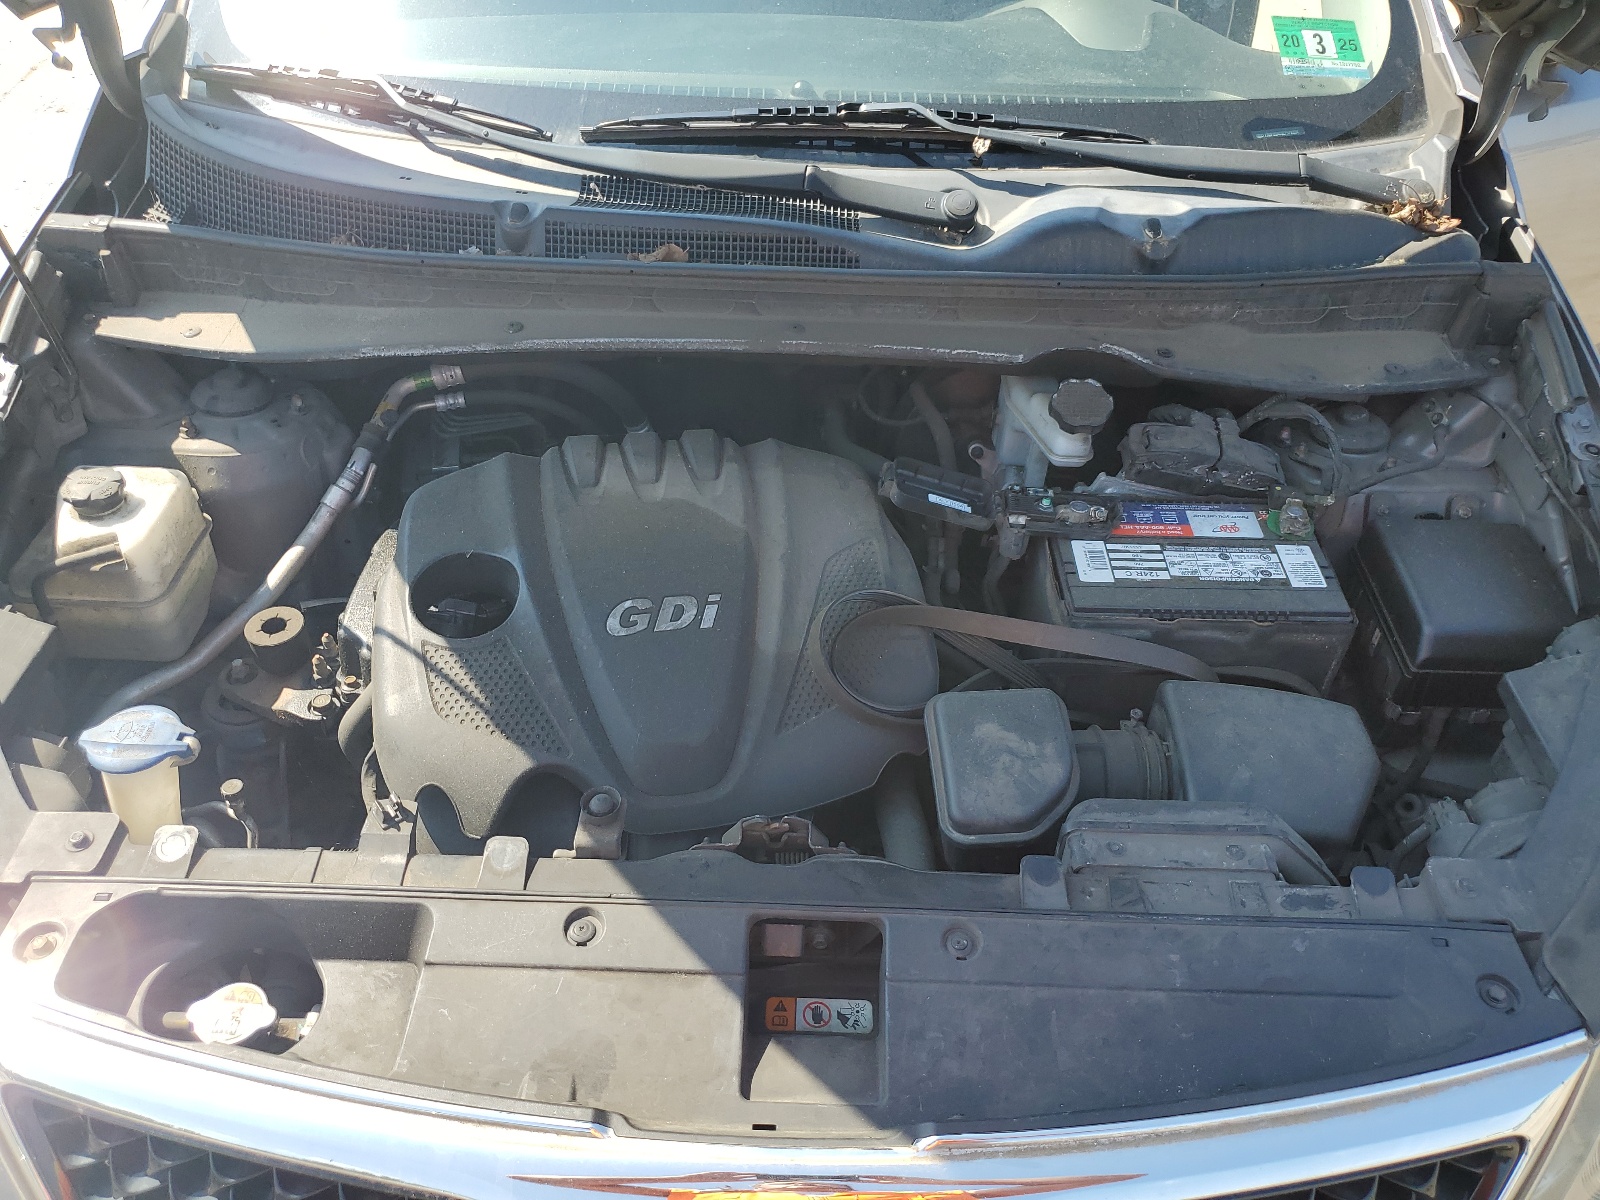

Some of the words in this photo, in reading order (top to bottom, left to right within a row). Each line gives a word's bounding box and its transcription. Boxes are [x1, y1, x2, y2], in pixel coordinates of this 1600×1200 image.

[1281, 34, 1300, 48] 20
[1312, 33, 1327, 55] 3
[1338, 38, 1359, 52] 25
[606, 594, 722, 636] GDi
